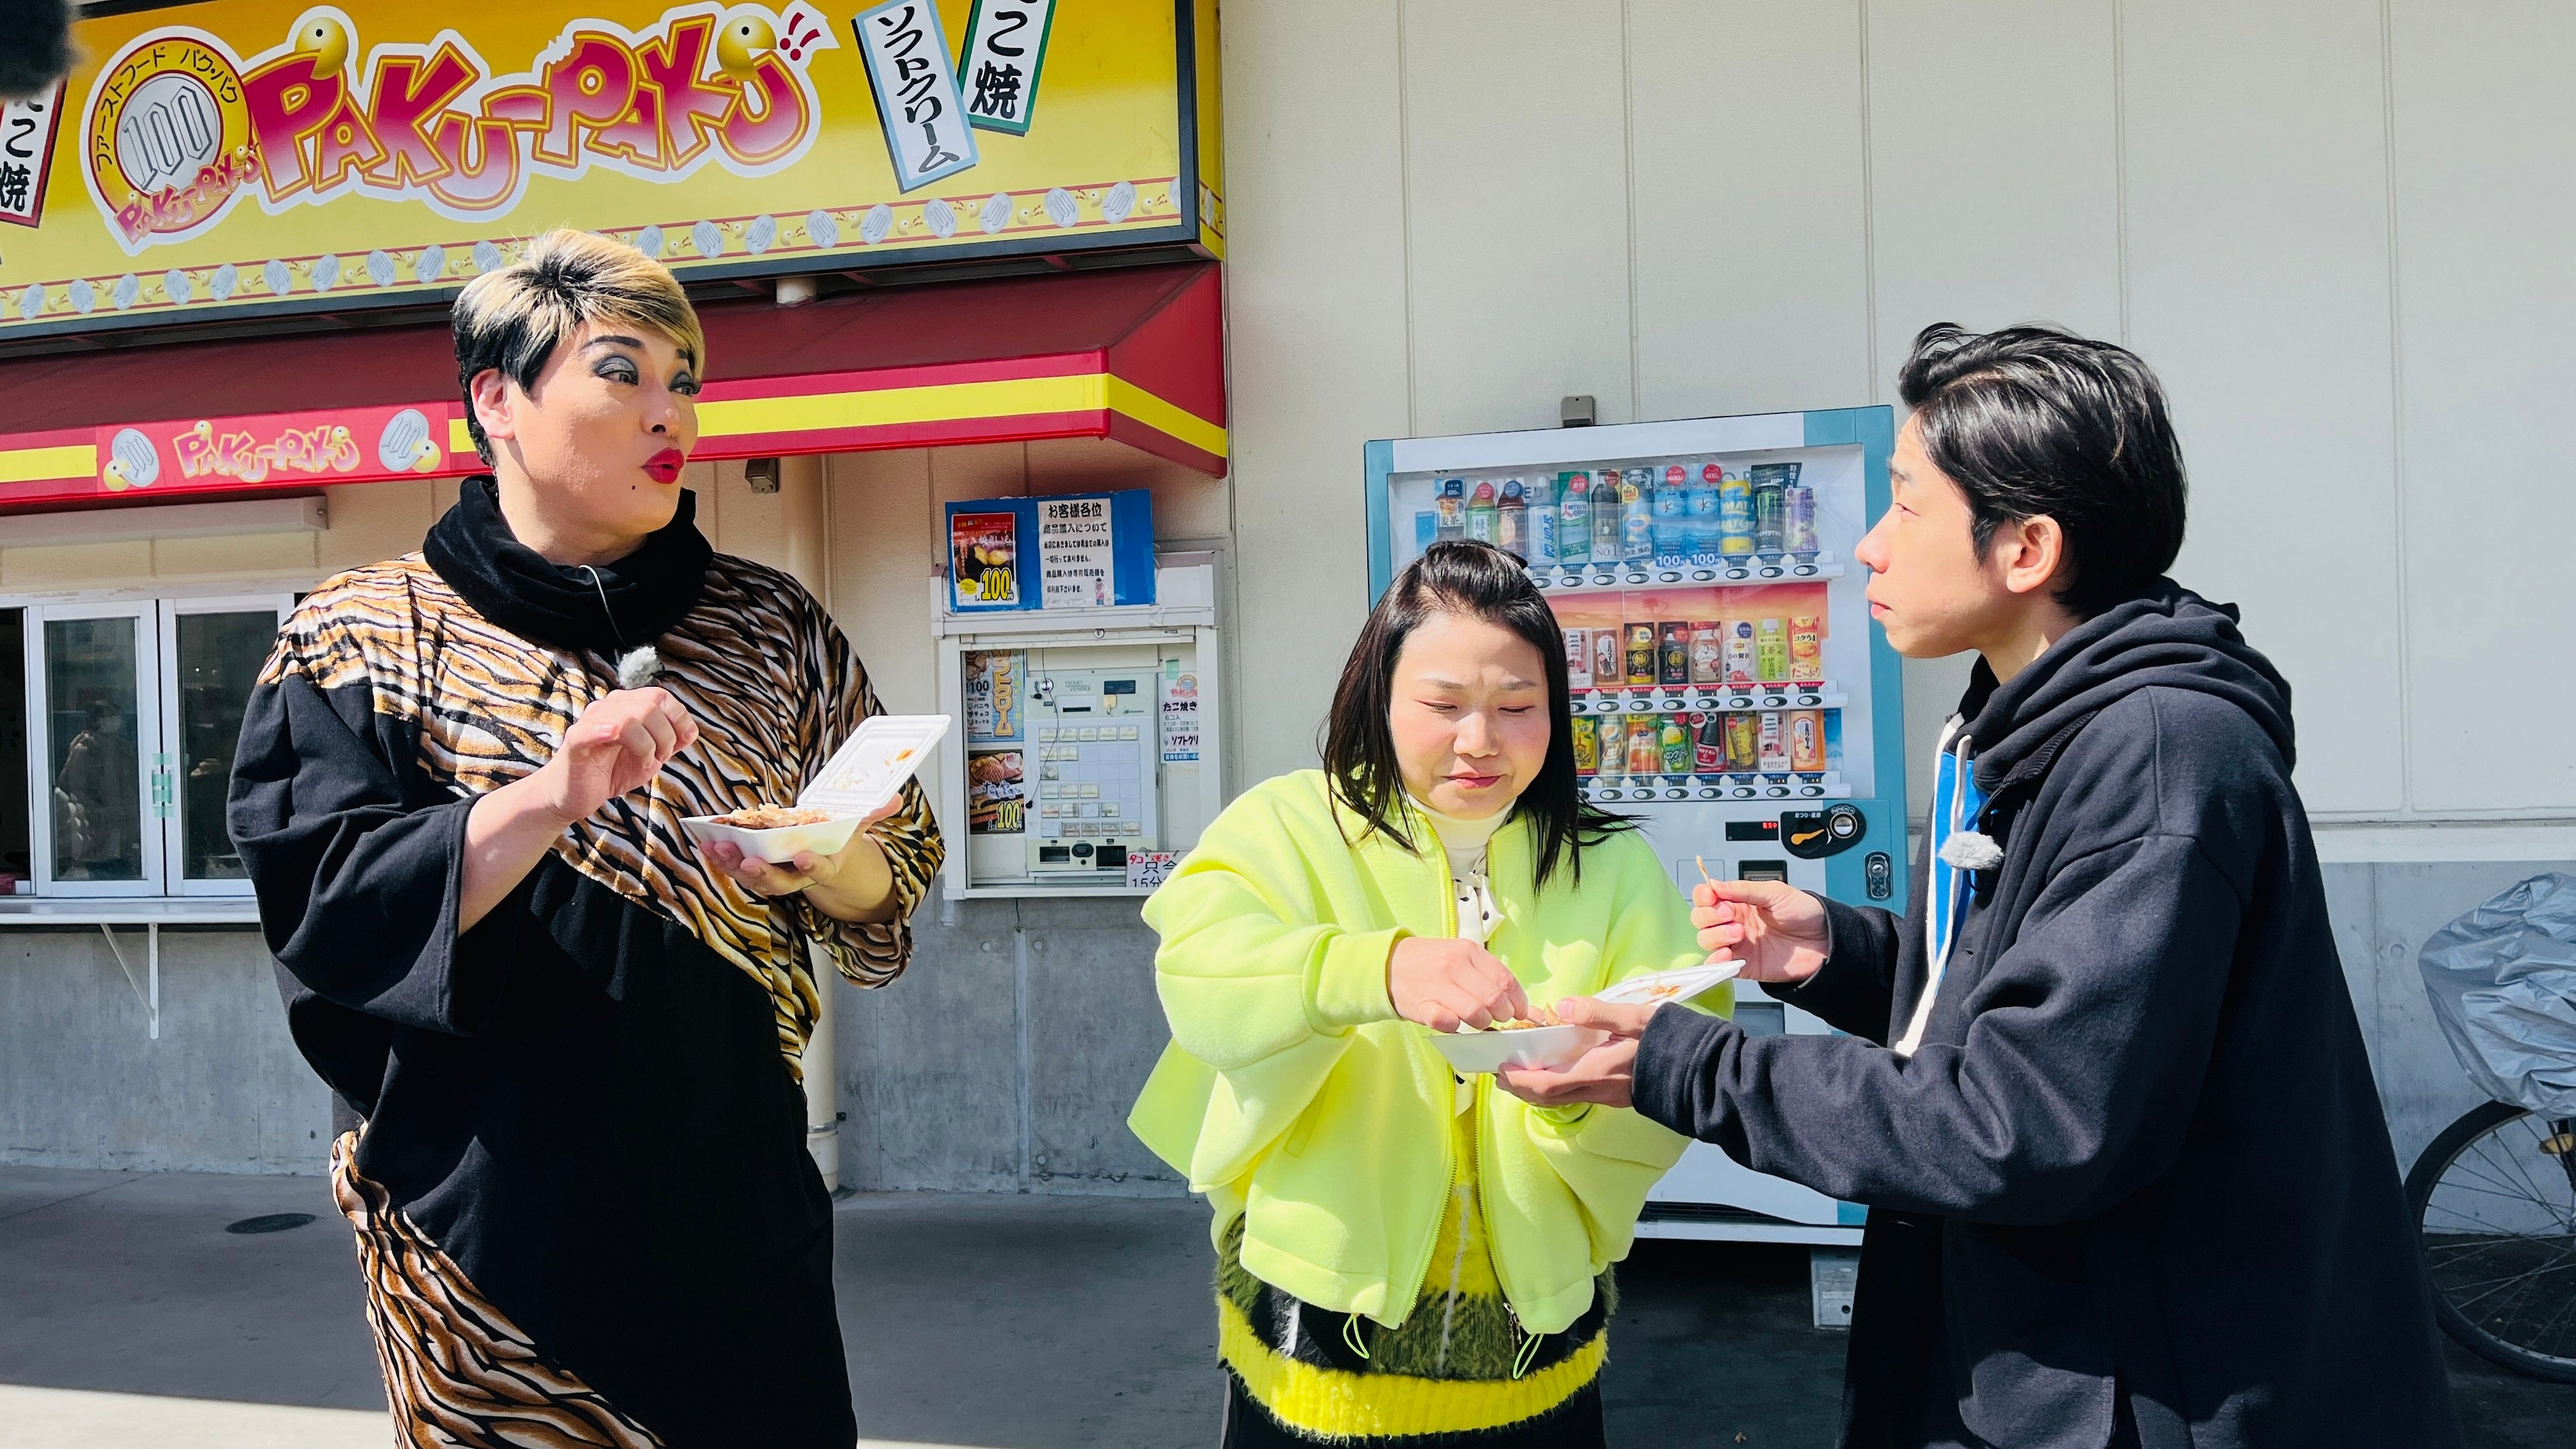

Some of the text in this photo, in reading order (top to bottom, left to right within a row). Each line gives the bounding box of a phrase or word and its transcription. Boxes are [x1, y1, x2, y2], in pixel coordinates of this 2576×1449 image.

[180, 48, 238, 104] パク・パク
[970, 0, 1040, 120] こ焼
[97, 46, 166, 172] ファーストフード
[878, 6, 960, 174] ソフトクリーム
[0, 100, 44, 211] こ焼
[123, 85, 213, 190] 100
[173, 424, 360, 483] PAKU-PAKU
[1043, 522, 1108, 535] 商品購入について
[1048, 502, 1102, 518] お客様各位
[1792, 667, 1821, 678] たっぷり
[1163, 701, 1198, 712] たこ焼き
[1132, 876, 1167, 888] 15分
